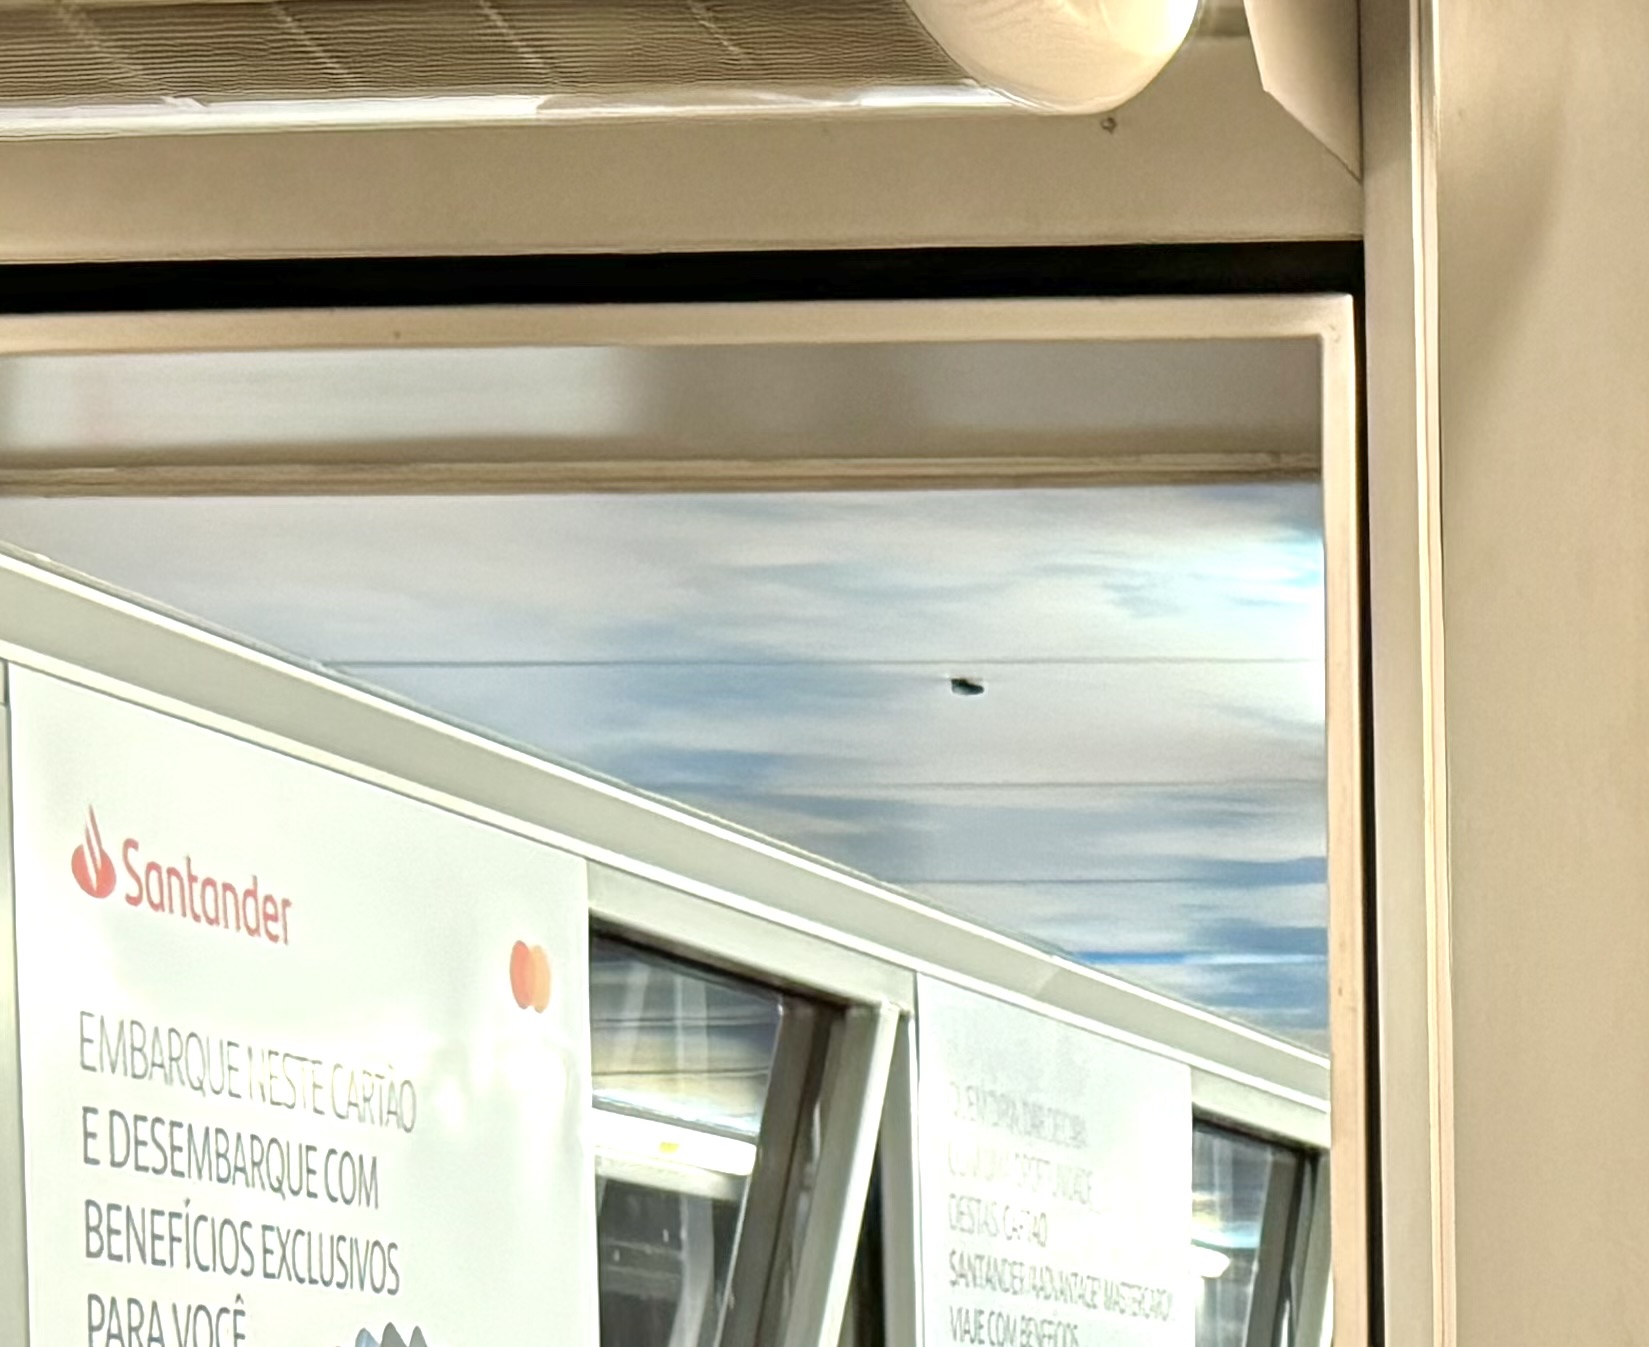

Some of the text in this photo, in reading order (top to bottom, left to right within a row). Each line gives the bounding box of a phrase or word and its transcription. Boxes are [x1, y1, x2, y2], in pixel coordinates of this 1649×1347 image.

[122, 838, 292, 945] Santander
[80, 1011, 417, 1133] EMBARQUE NESTE CARTÃO
[82, 1106, 379, 1210] E DESEMBARQUE COM
[84, 1197, 400, 1296] BENEFÍCIOS EXCLUSIVOS
[949, 1305, 985, 1345] VIAJE
